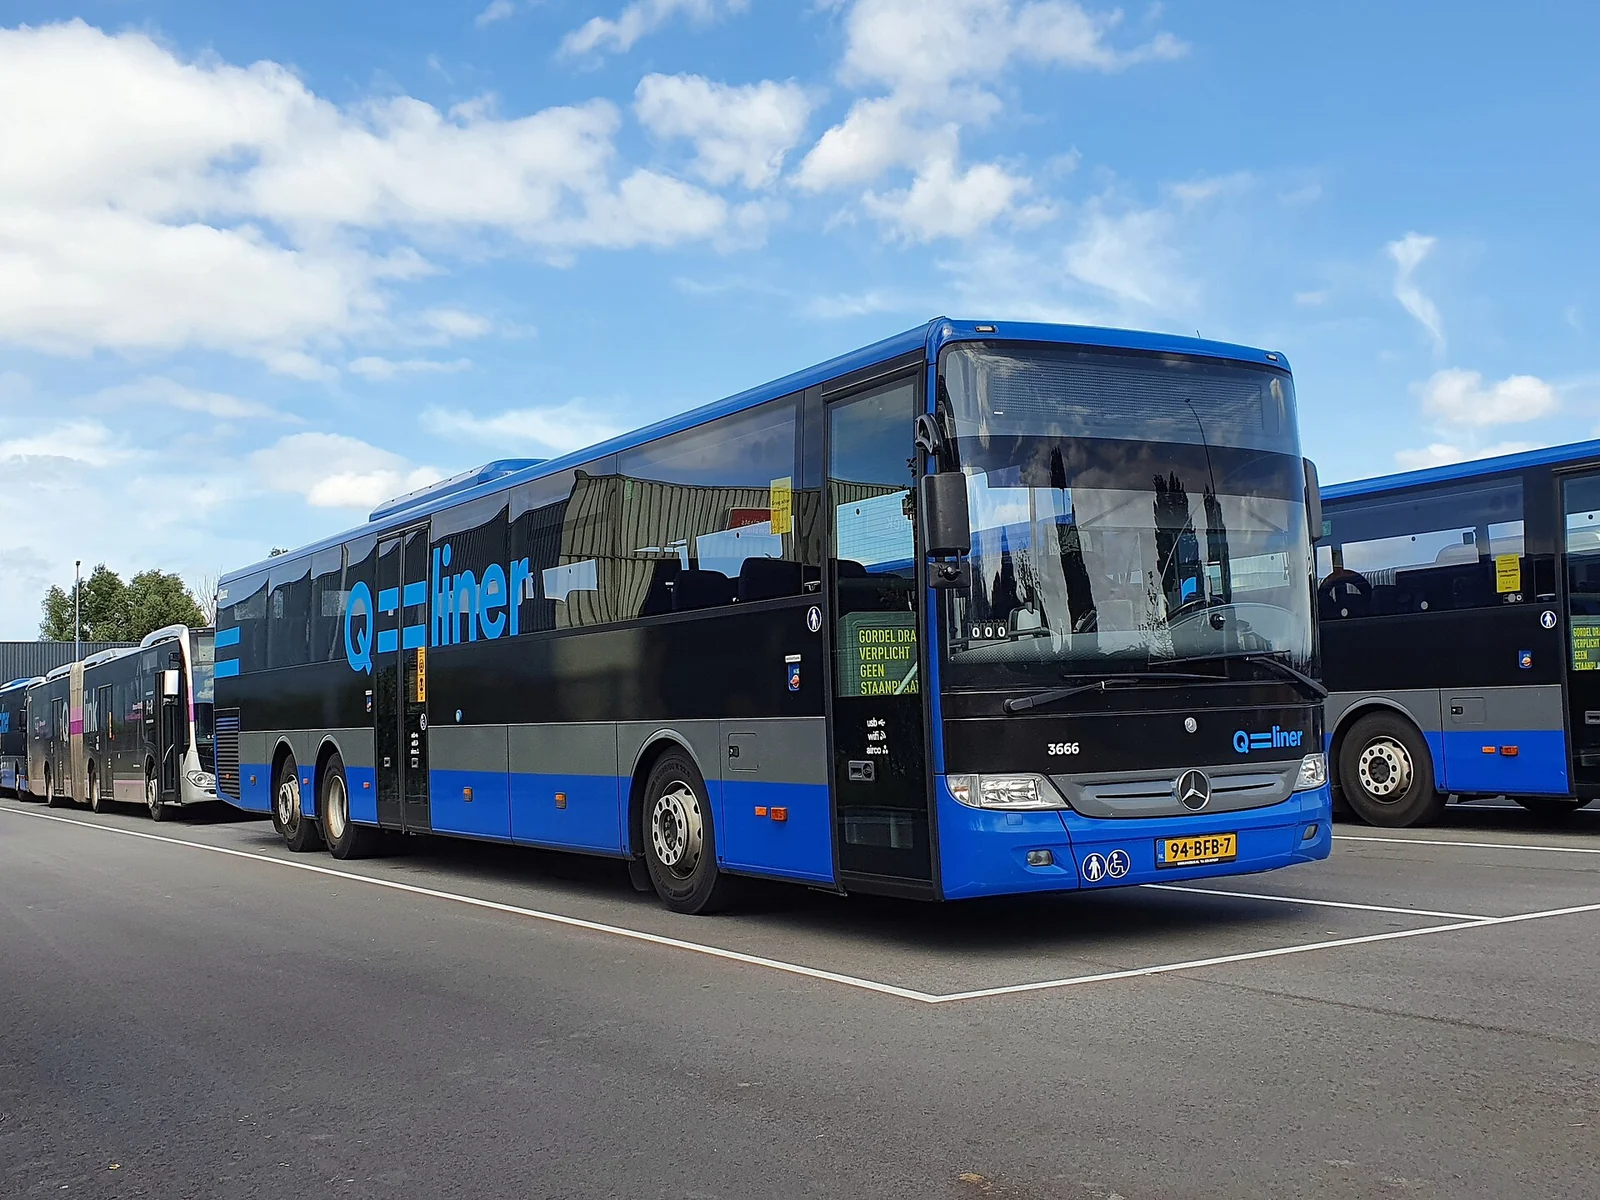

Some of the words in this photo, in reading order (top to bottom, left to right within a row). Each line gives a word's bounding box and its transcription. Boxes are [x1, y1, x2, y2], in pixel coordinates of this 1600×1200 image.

[858, 629, 896, 643] GORDEL
[859, 646, 911, 660] VERPLICHT
[860, 663, 886, 678] GEEN
[1047, 742, 1080, 756] 3666
[1170, 837, 1232, 859] 94-BFB-7
